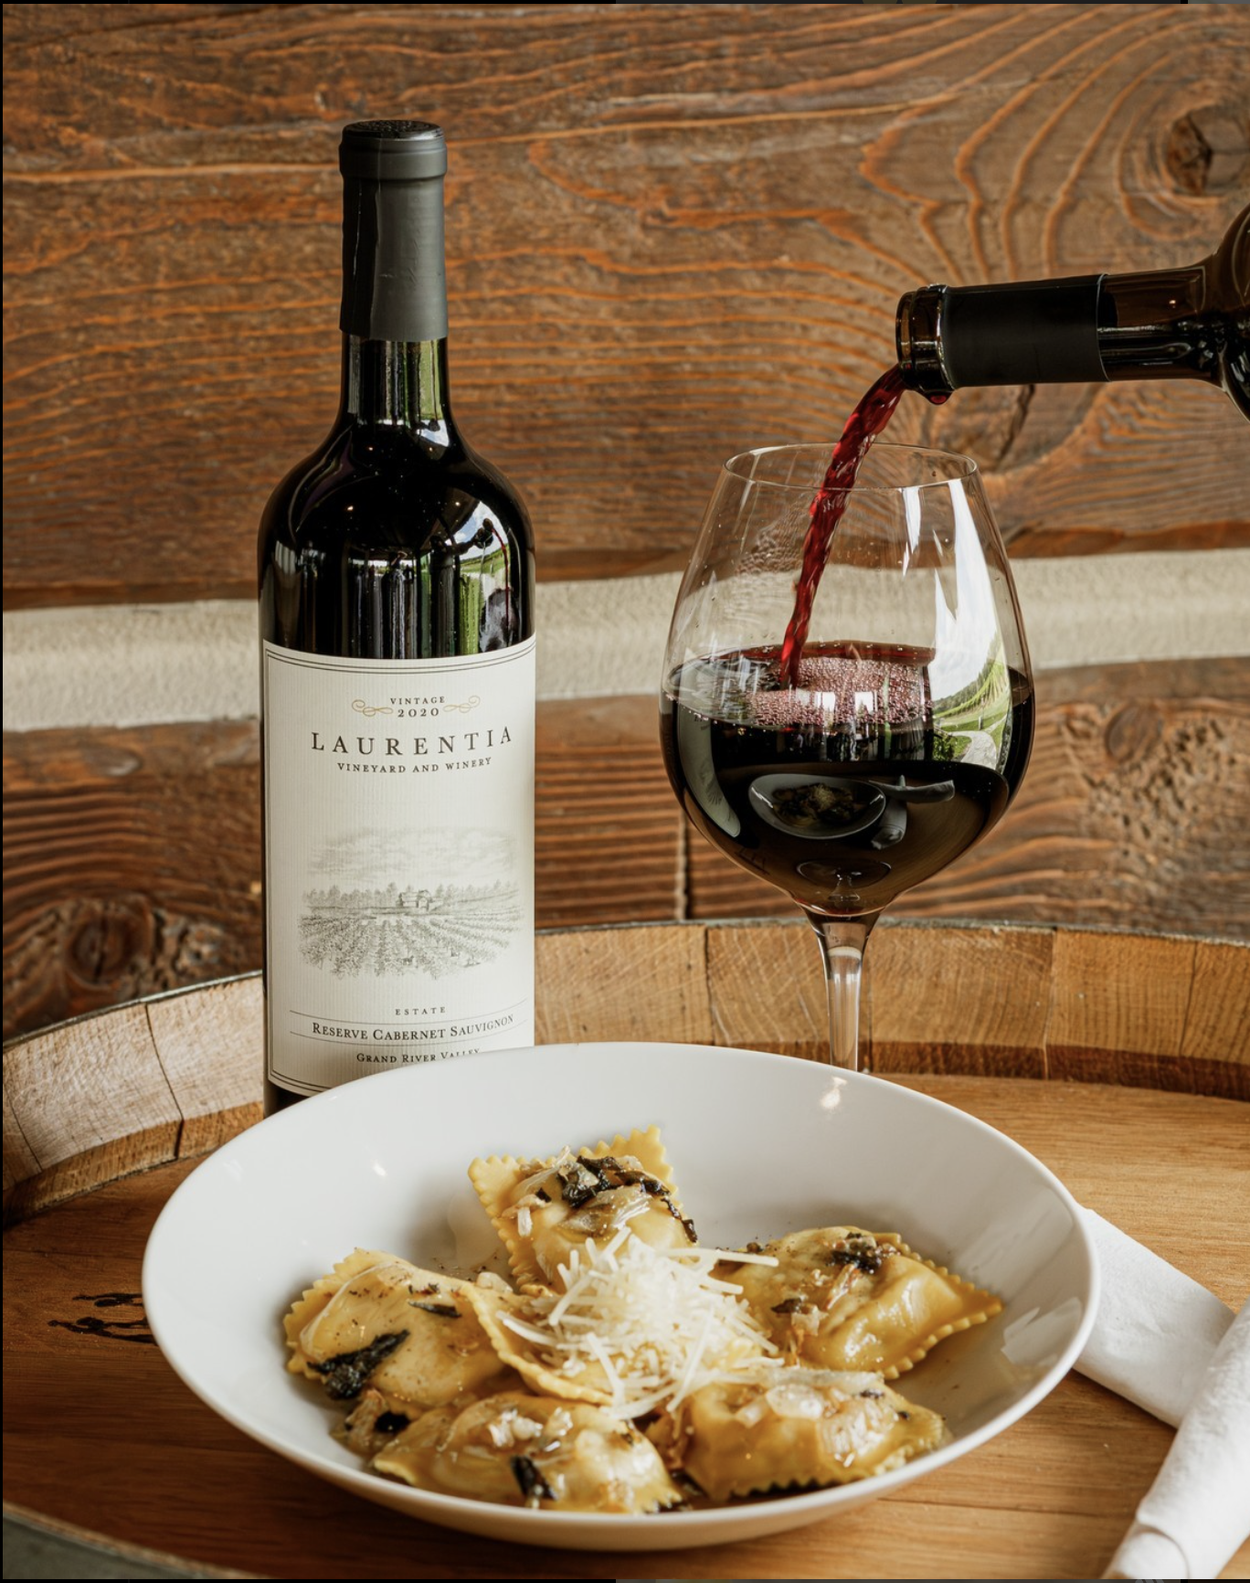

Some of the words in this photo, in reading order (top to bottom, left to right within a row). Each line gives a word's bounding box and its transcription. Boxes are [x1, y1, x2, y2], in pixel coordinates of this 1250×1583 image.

[390, 696, 446, 705] VINTAGE
[397, 707, 440, 718] 2020
[311, 726, 512, 756] LAURENTIA
[337, 762, 406, 774] VINEYARD
[412, 764, 440, 773] AND
[446, 757, 492, 770] WINERY
[395, 1006, 446, 1016] ESTATE
[312, 1022, 368, 1040] RESERVE
[373, 1028, 446, 1041] CABERNET
[450, 1014, 514, 1037] SAUVIGNON
[356, 1052, 398, 1063] GRAND
[402, 1053, 437, 1063] RIVER
